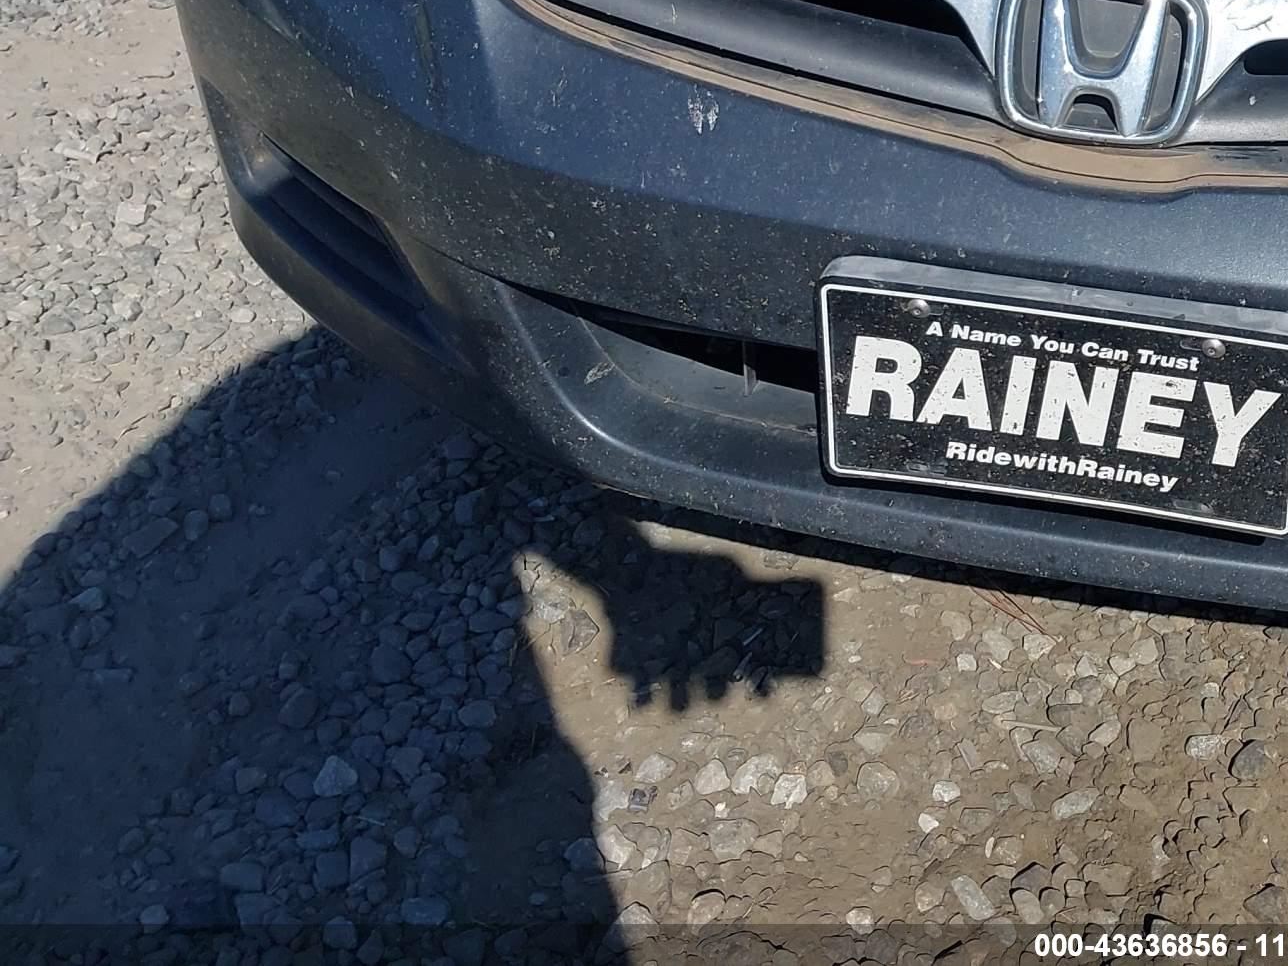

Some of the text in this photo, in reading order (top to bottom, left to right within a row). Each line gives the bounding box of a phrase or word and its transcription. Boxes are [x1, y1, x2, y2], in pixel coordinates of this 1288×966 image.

[925, 321, 1200, 372] A Name You Can Trust
[845, 335, 1282, 468] RAINEY
[945, 441, 1179, 493] RidewithRainey
